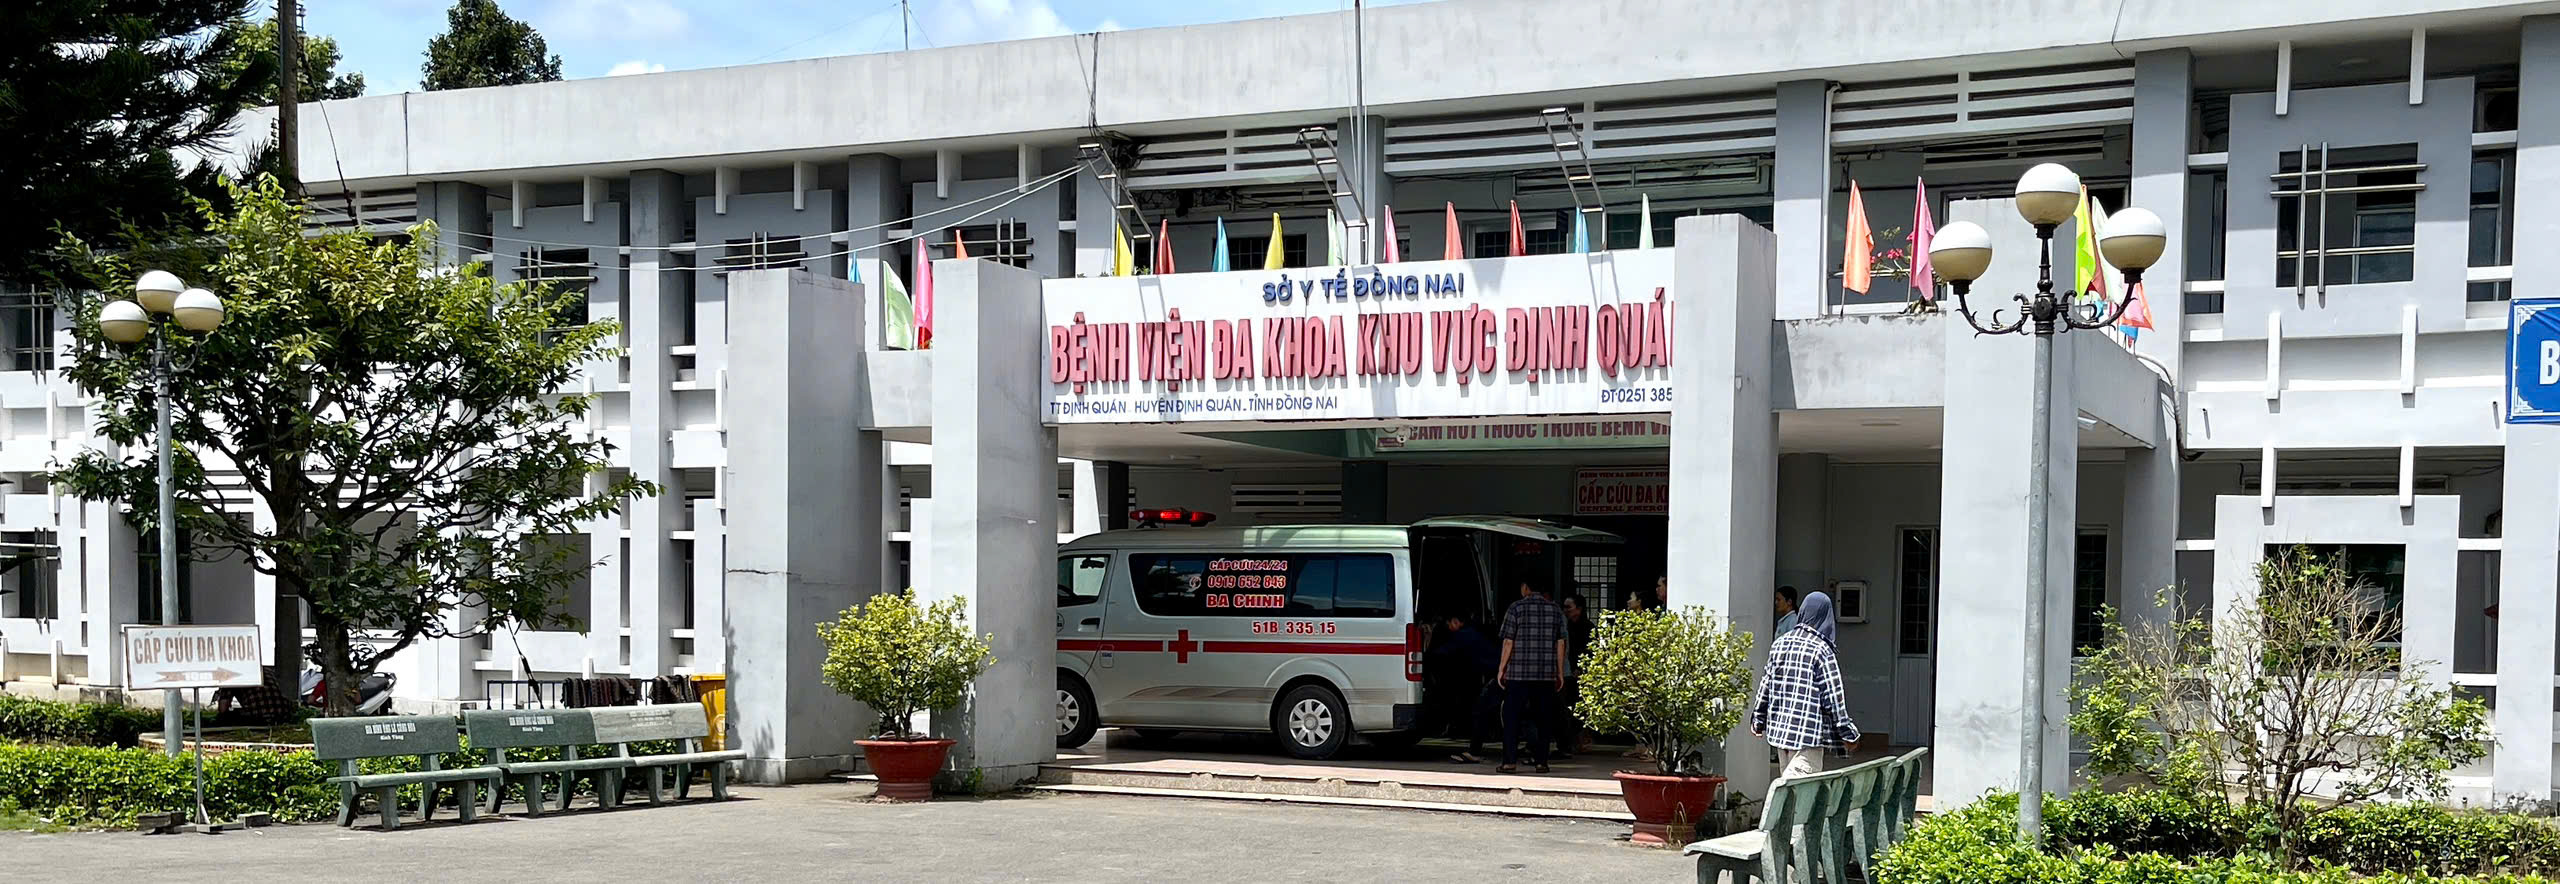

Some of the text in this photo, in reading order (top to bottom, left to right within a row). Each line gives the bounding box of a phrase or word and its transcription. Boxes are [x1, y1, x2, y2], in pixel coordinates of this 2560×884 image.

[1262, 268, 1464, 301] SỞ Y TẾ ĐỒNG NAI
[1050, 287, 1674, 394] BỆNH VIỆN ĐA KHOA KHU VỰC ĐỊNH QUÁ
[1063, 400, 1090, 417] ĐỊNH
[1134, 397, 1174, 416] HUYỆN
[1175, 398, 1203, 415] ĐỊNH
[1248, 394, 1274, 412] TỈNH
[1276, 393, 1313, 411] ĐỒNG
[1315, 395, 1338, 410] NAI
[1579, 478, 1604, 505] CẤP
[1606, 480, 1633, 504] CỨU
[1635, 484, 1654, 504] ĐA
[1207, 575, 1286, 588] 0919 652 843
[1206, 594, 1285, 608] BA CHINH
[133, 630, 256, 664] CẤP CỨU ĐA KHOA
